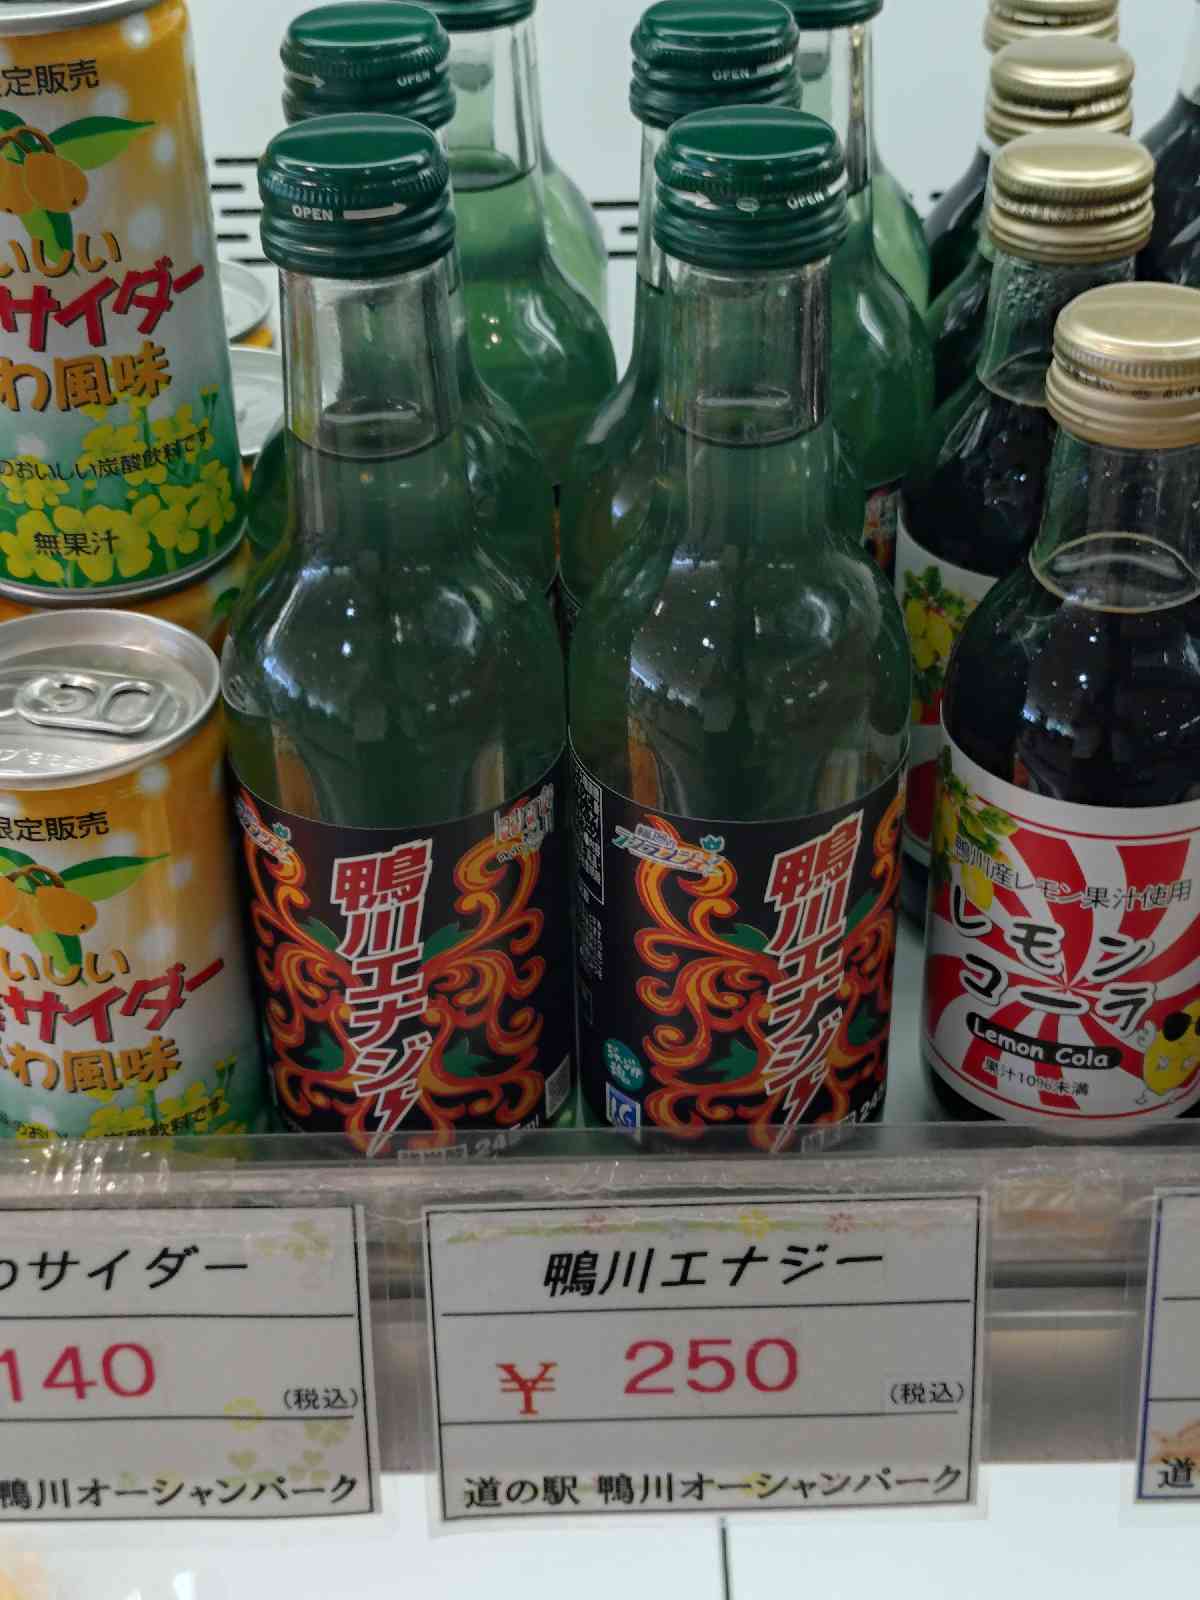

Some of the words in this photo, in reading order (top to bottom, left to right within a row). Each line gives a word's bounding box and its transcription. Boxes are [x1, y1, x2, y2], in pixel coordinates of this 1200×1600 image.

[0, 59, 99, 97] 定販売
[291, 204, 333, 221] OPEN
[787, 192, 825, 210] OPEN
[0, 256, 205, 352] サイダー
[34, 529, 119, 556] 無果汁
[951, 883, 1150, 980] レモン
[0, 958, 224, 1044] サイダー
[962, 953, 1149, 1031] コーラ
[0, 1035, 182, 1093] わ風味
[973, 1017, 1045, 1060] Lemon
[1055, 1047, 1109, 1067] Cola
[543, 1243, 883, 1298] 鴨川エナジー
[0, 1343, 155, 1403] 140
[496, 1362, 557, 1414] ¥
[624, 1338, 799, 1395] 250
[0, 1474, 358, 1510] 鴨川オーシャンパーク
[464, 1475, 580, 1509] 道の駅
[597, 1464, 962, 1505] 鴨川オーシャンパーク
[1158, 1455, 1196, 1490] 道
